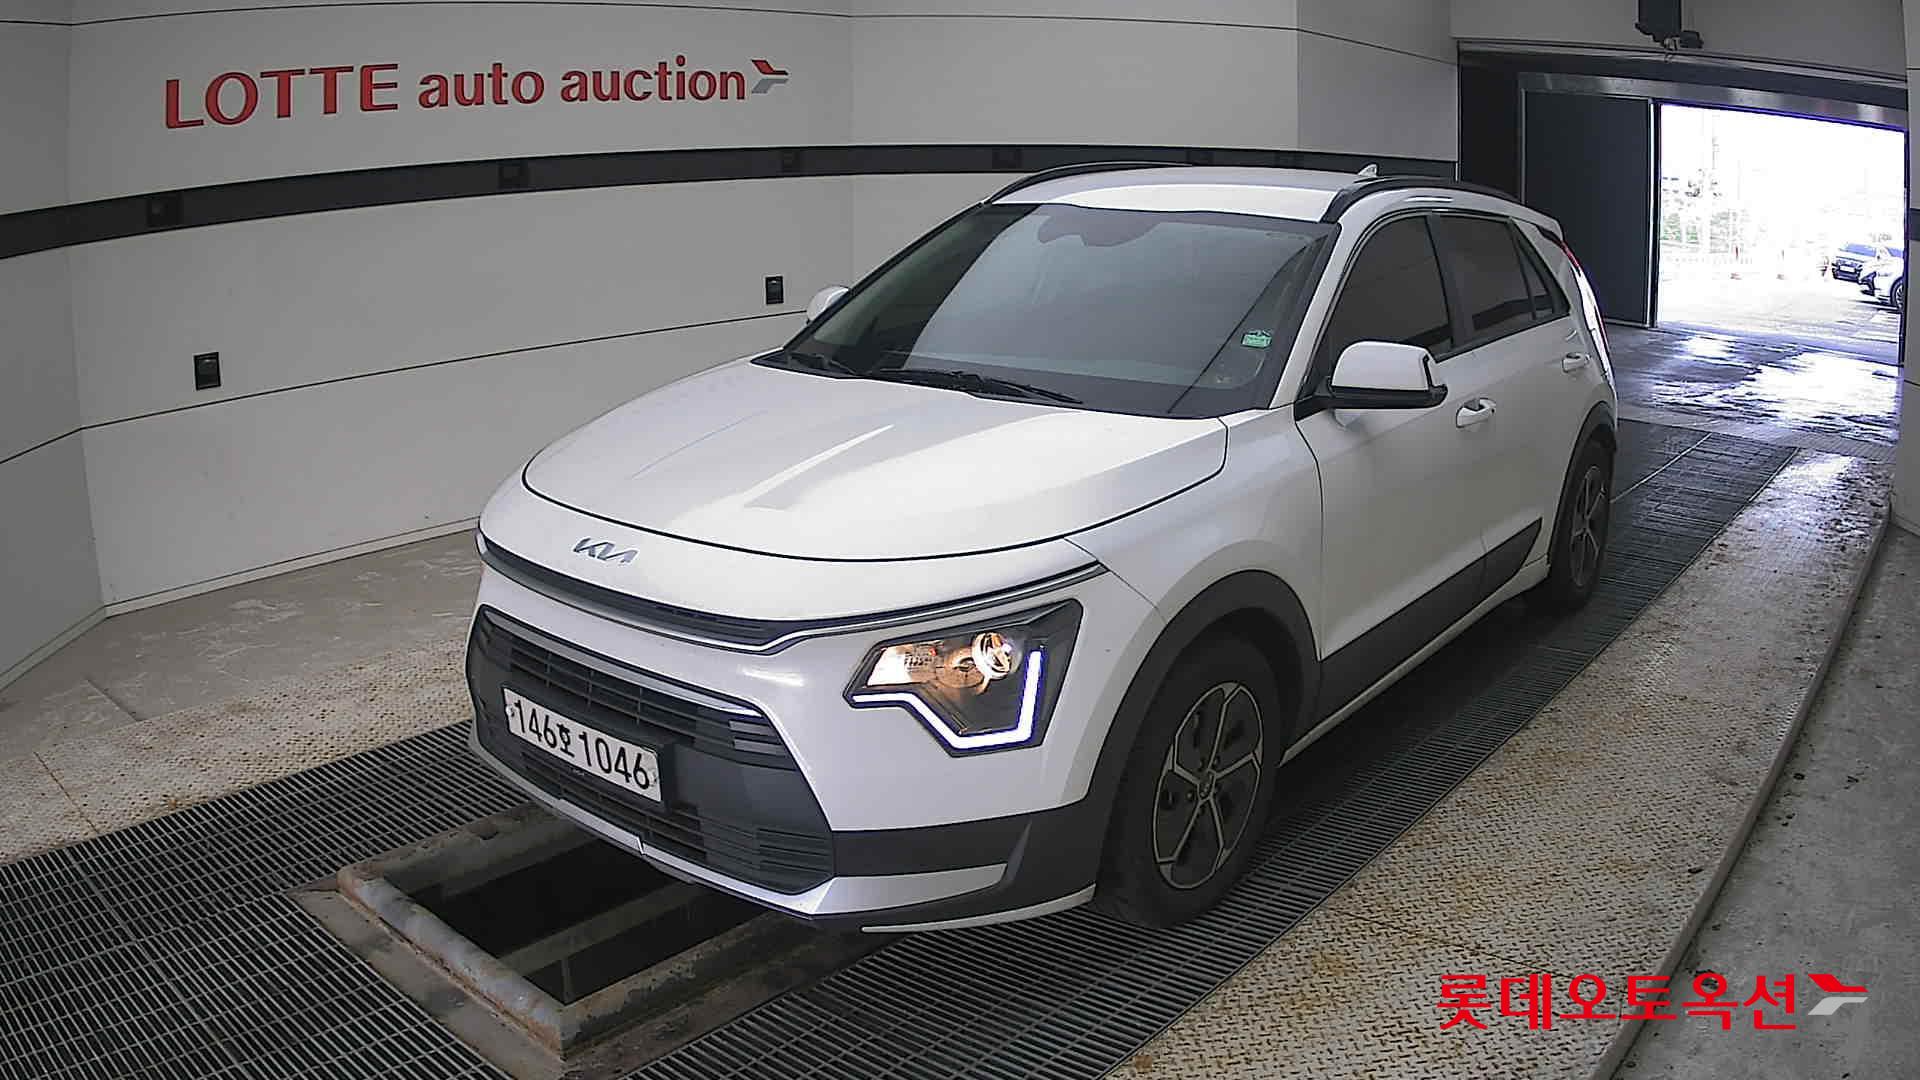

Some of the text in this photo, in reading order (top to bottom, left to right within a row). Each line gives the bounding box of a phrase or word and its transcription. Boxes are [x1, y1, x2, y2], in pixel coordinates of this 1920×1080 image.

[165, 55, 746, 129] LOTTE auto auction
[578, 731, 650, 790] 1046
